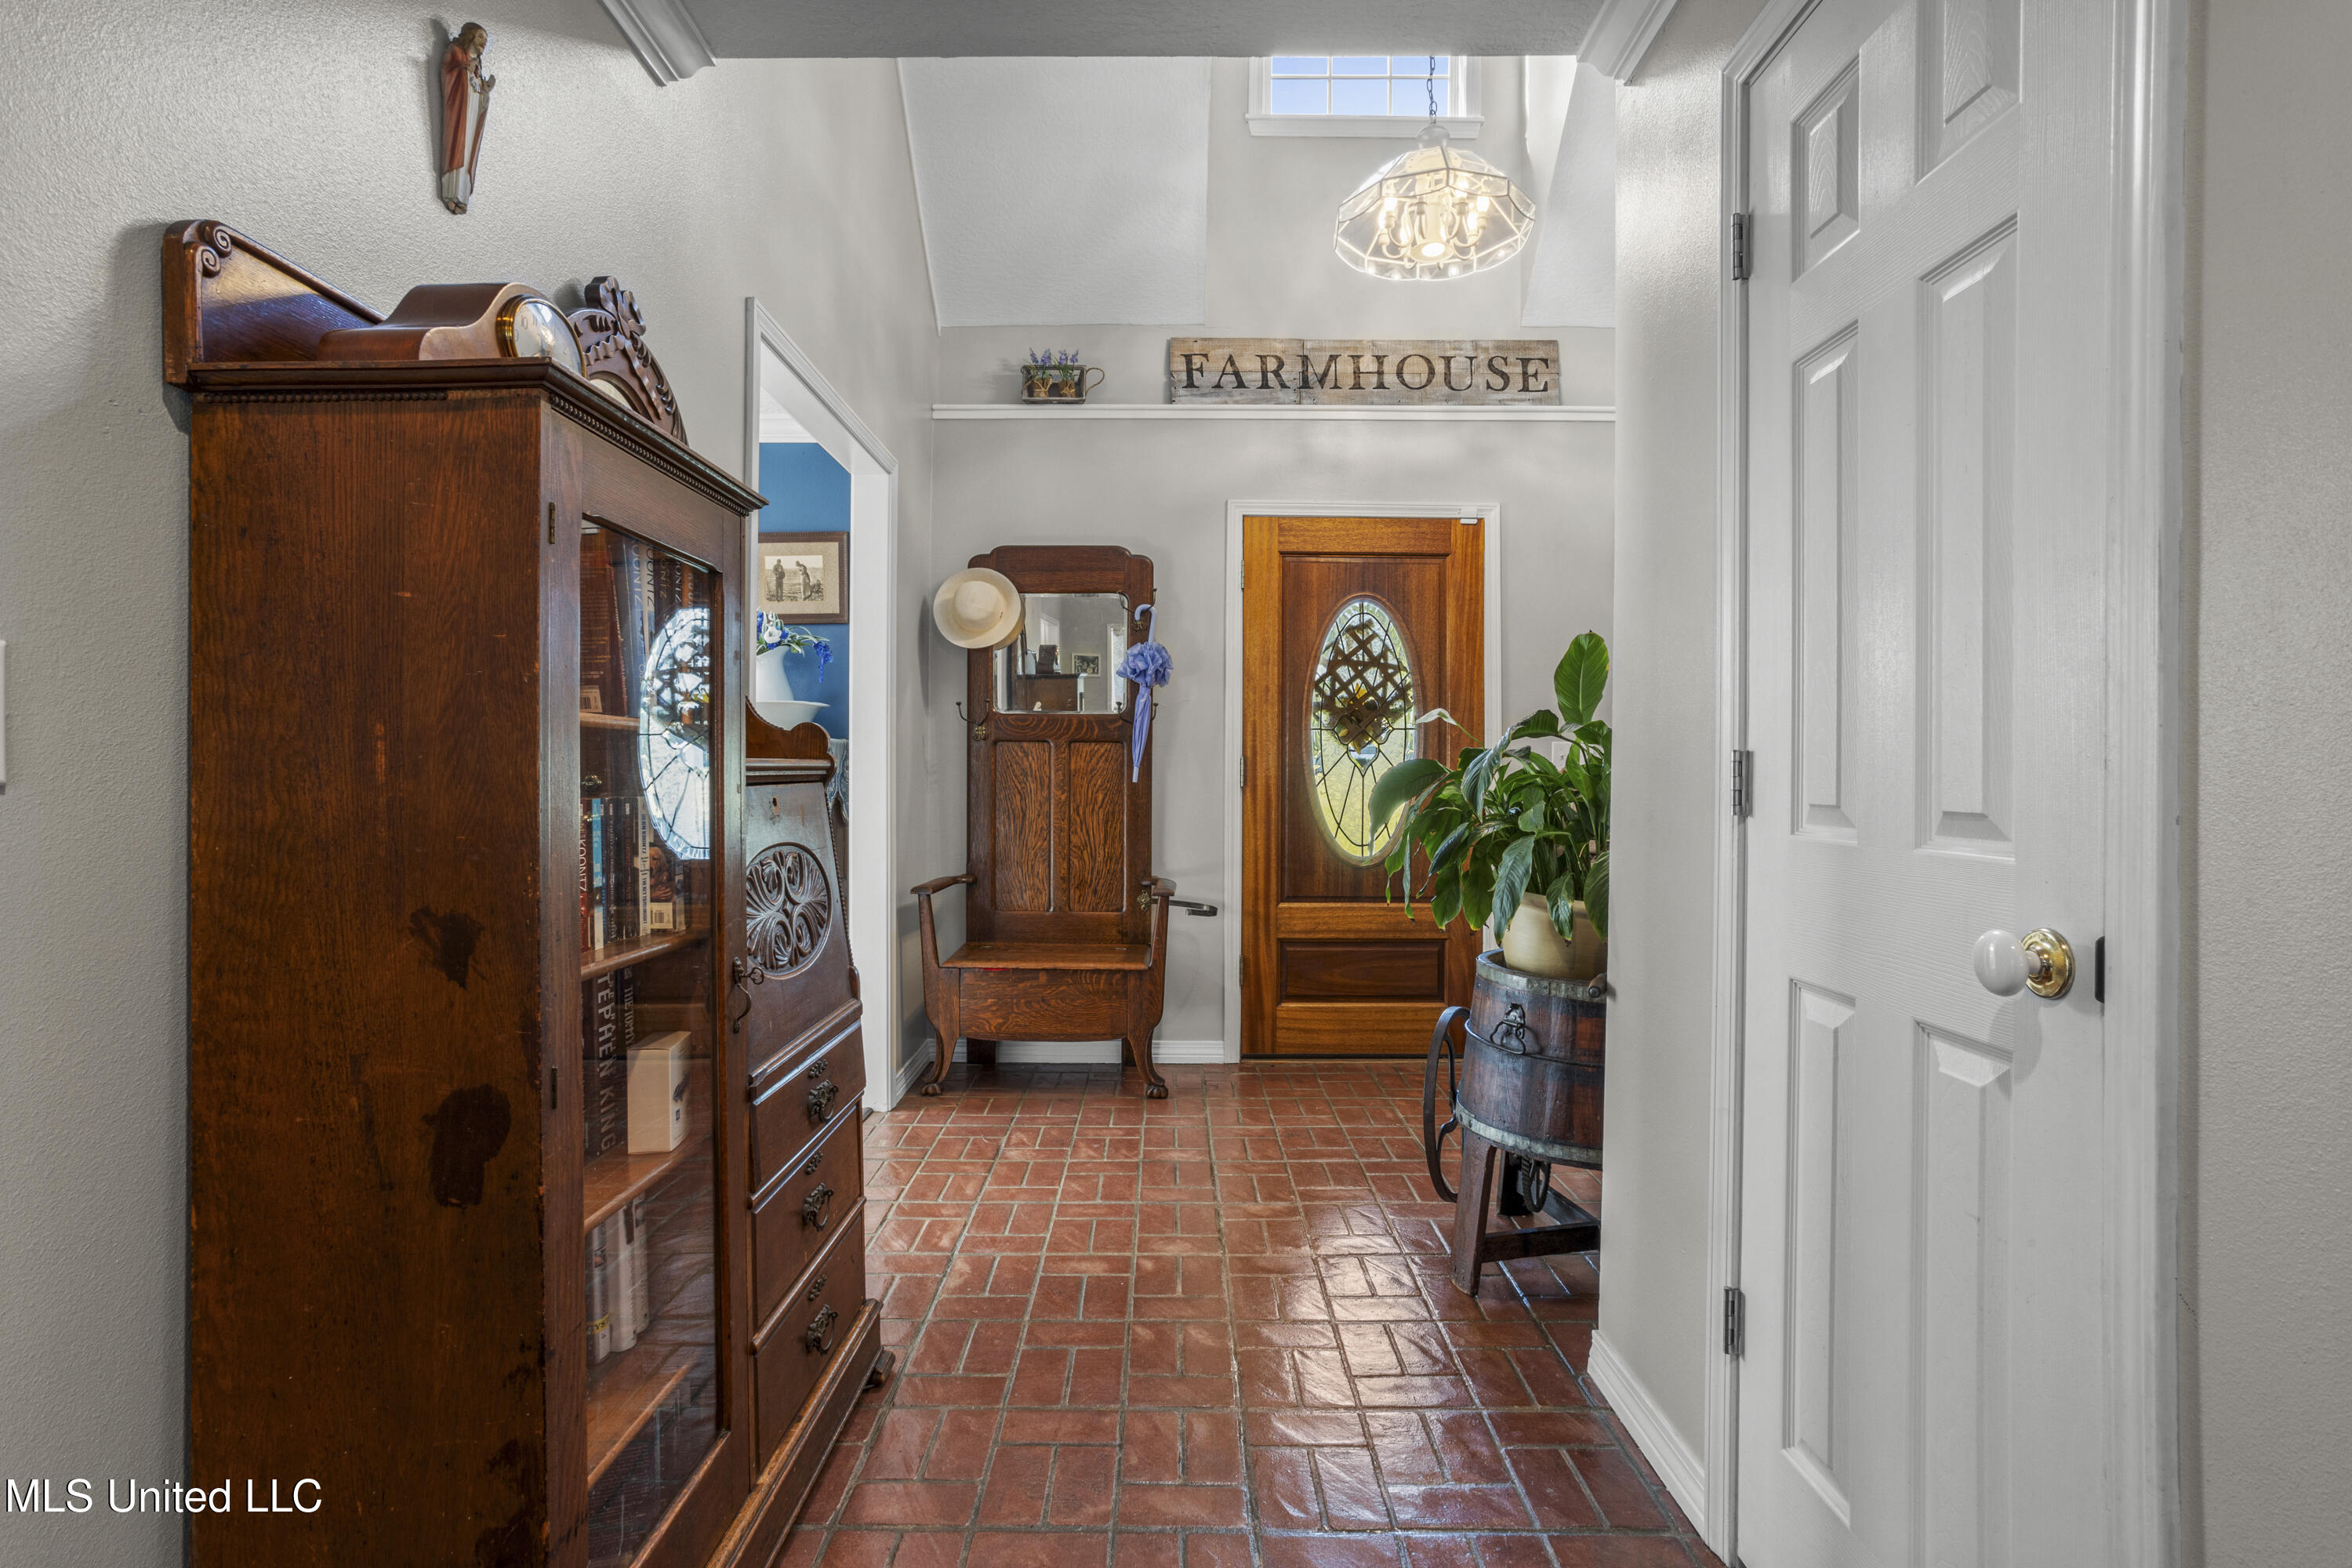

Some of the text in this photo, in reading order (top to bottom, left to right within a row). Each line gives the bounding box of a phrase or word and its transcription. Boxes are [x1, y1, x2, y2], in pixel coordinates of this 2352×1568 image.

[1180, 353, 1551, 393] FARMHOUSE
[633, 542, 642, 607] OONTZ
[647, 549, 655, 607] OONTZ
[624, 985, 633, 1009] THE
[625, 1010, 635, 1050] TOMMY
[597, 972, 615, 1152] TEPHEN KING
